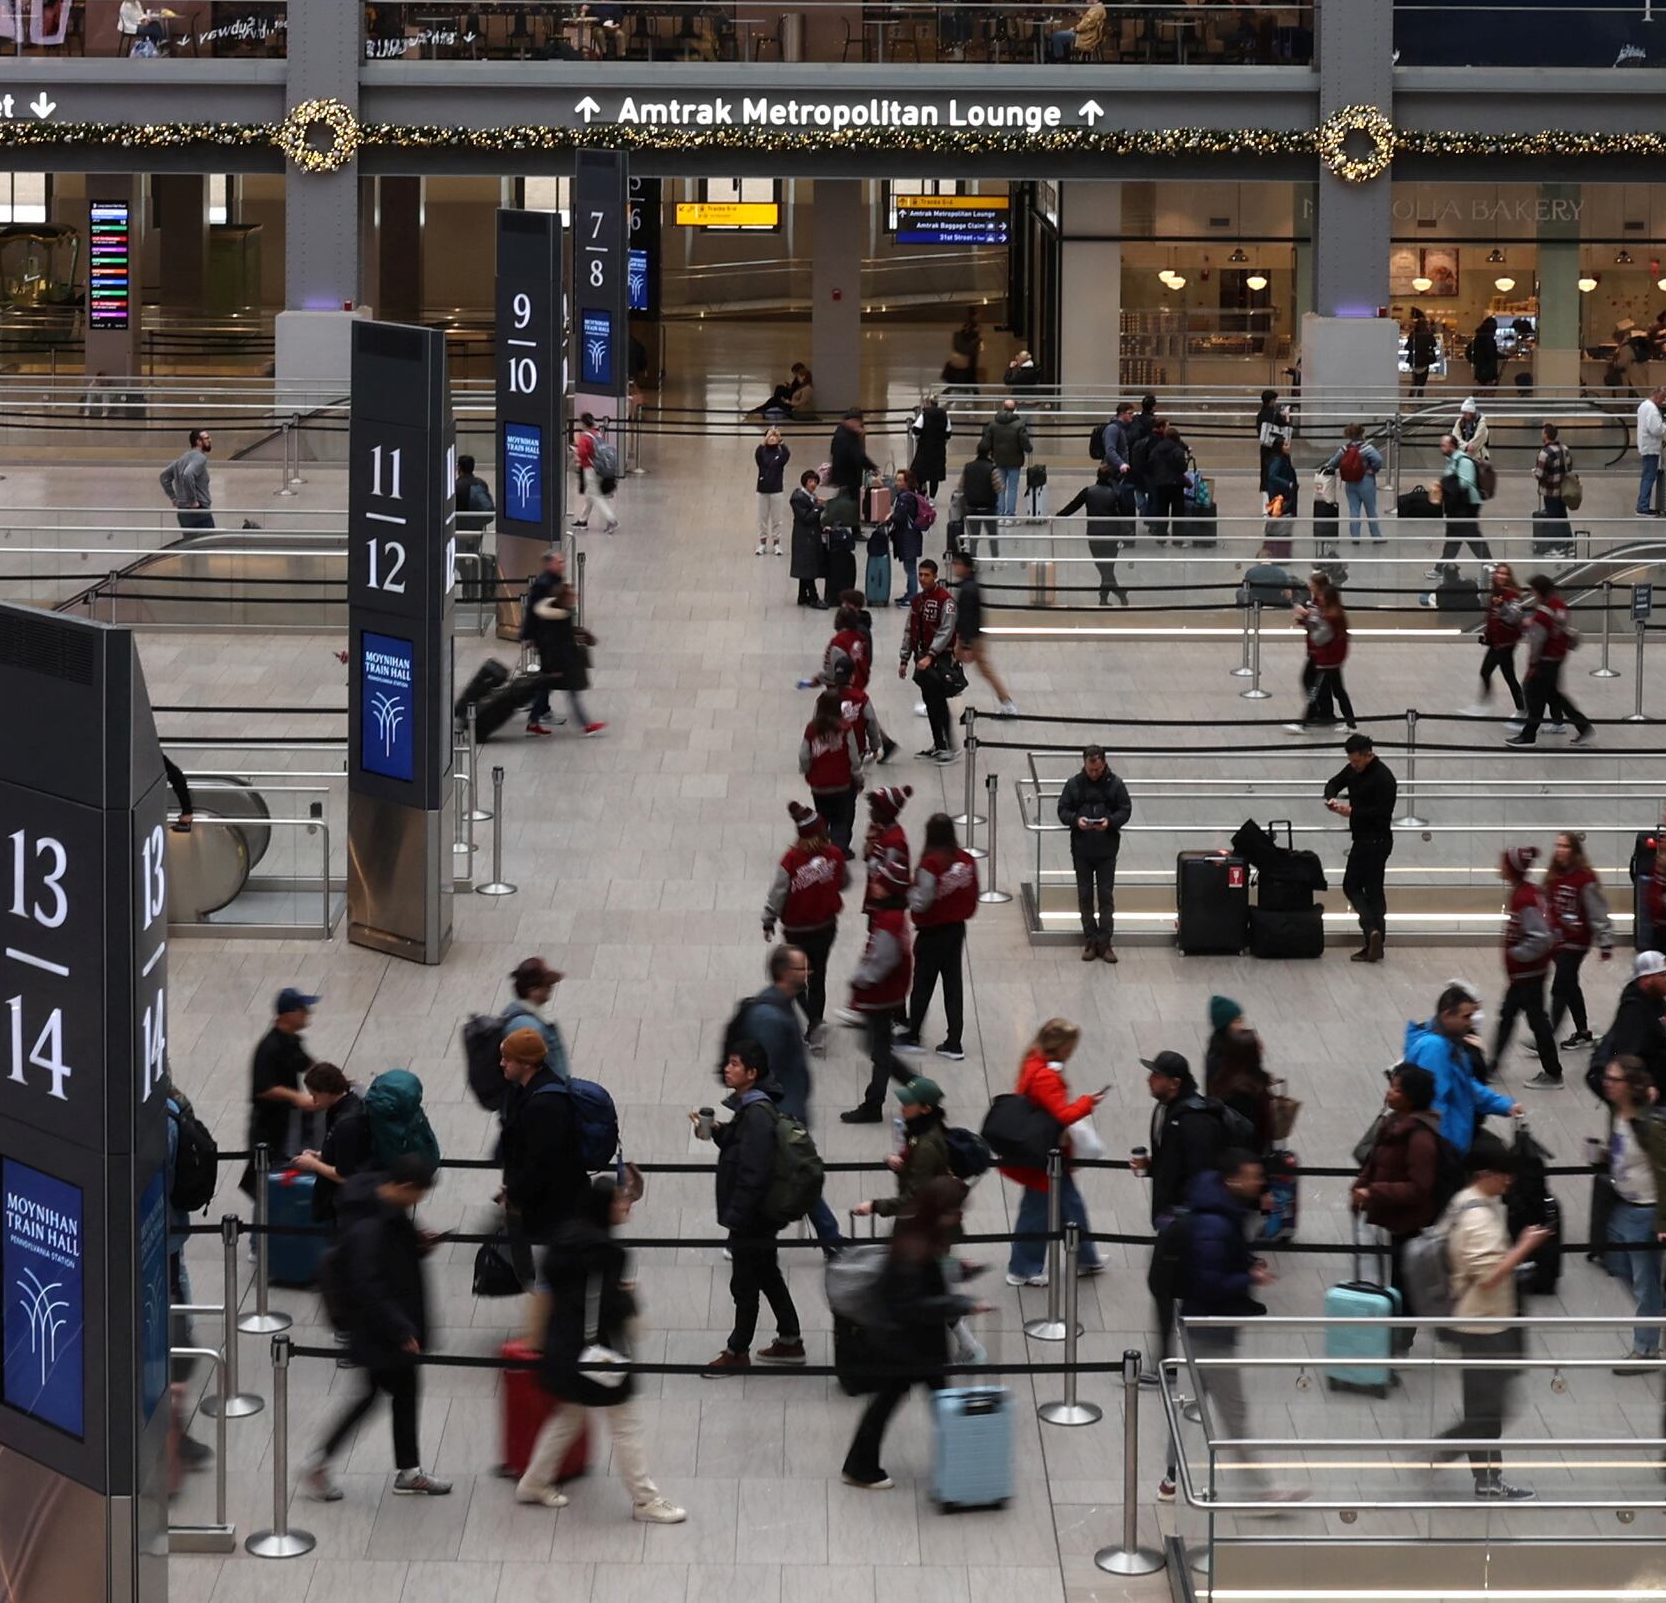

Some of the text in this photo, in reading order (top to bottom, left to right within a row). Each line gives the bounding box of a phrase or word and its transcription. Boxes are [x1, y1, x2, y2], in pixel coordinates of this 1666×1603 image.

[618, 96, 1062, 133] Amtrak Metropolitan Lounge
[590, 212, 604, 239] 7
[630, 208, 642, 231] 6
[933, 210, 972, 218] Metropolitan
[973, 210, 996, 218] Lounge
[940, 222, 967, 230] Baggage
[1473, 199, 1585, 221] BAKERY
[954, 234, 973, 242] Street
[589, 259, 604, 287] 8
[513, 293, 532, 329] 9
[507, 357, 538, 395] 10
[370, 444, 404, 501] 11
[365, 536, 407, 595] 12
[365, 650, 410, 669] MOYNIHAN
[365, 661, 412, 682] TRAIN HALL
[8, 828, 68, 928] 13
[141, 824, 165, 932] 13
[4, 993, 72, 1102] 14
[141, 987, 166, 1103] 14
[6, 1191, 78, 1237] MOYNIHAN
[5, 1209, 80, 1258] TRAIN HALL
[10, 1233, 76, 1270] PENNSYLVANIA STATION
